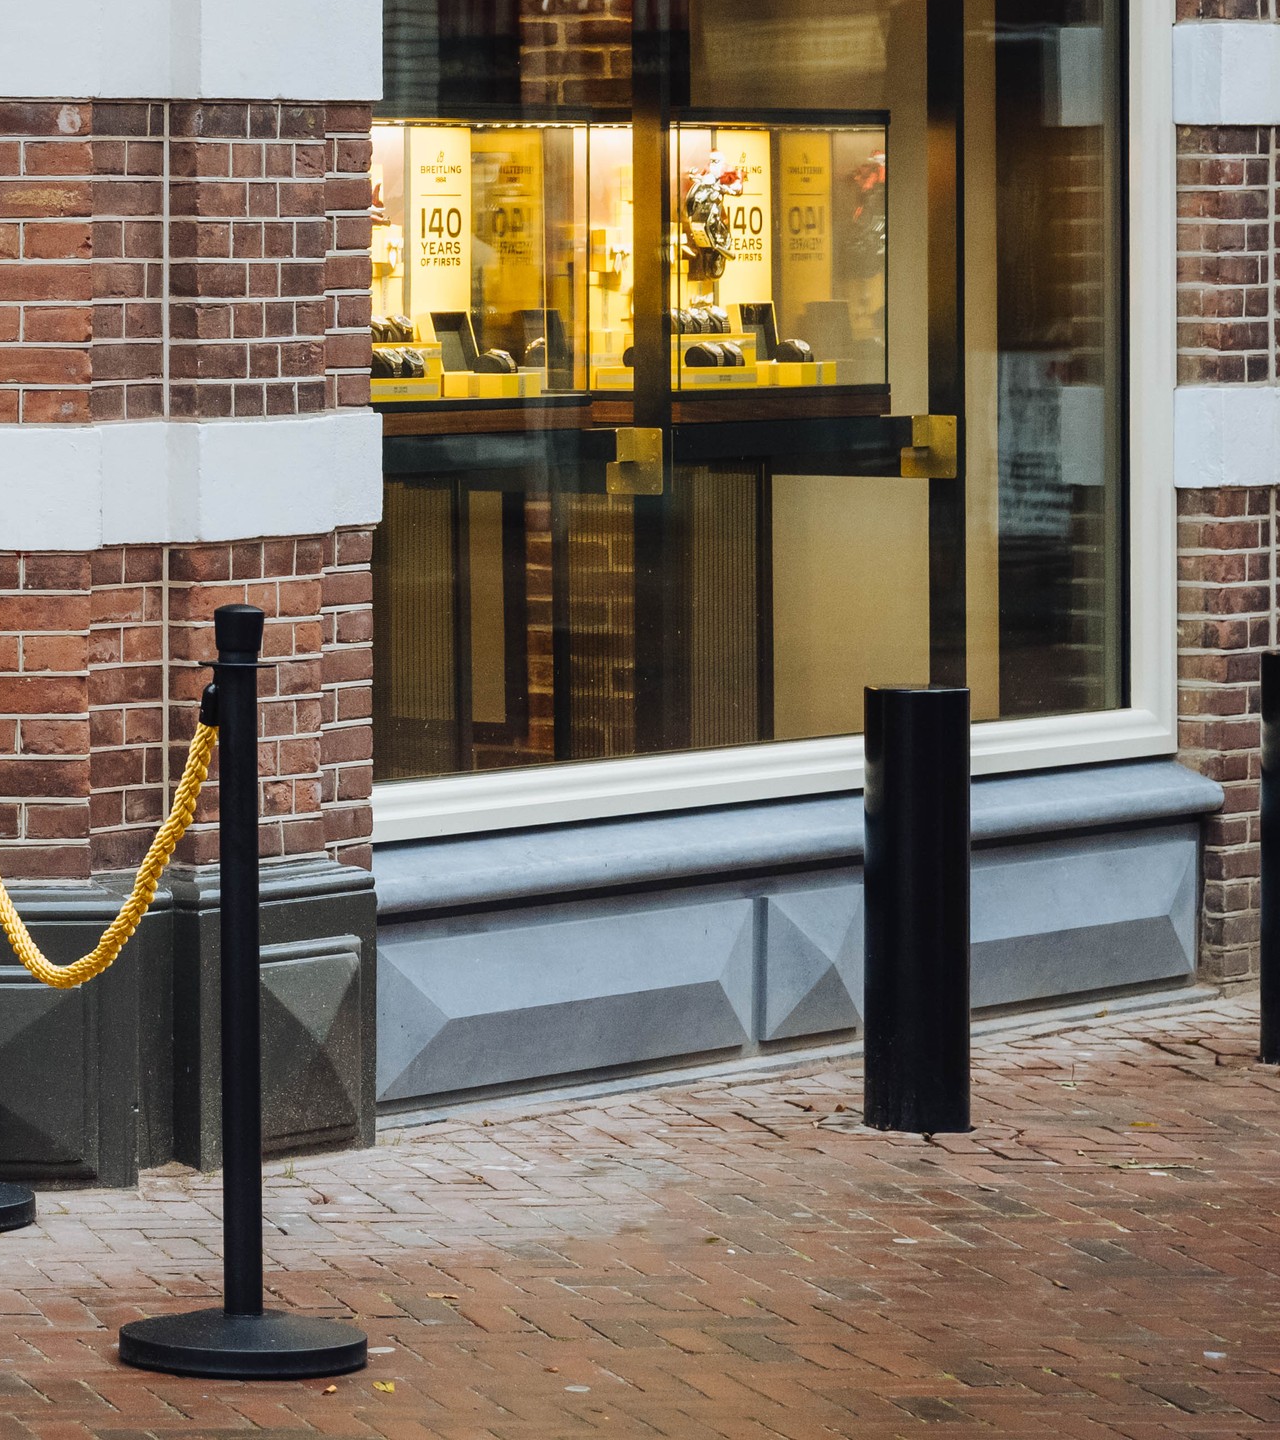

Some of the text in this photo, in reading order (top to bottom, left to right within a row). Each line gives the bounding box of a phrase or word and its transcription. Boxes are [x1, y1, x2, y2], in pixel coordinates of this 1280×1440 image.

[420, 165, 462, 174] BREITLING
[421, 207, 462, 239] 140
[421, 241, 461, 255] YEARS
[420, 257, 461, 267] OF FIRSTS
[737, 253, 763, 262] FIRSTS
